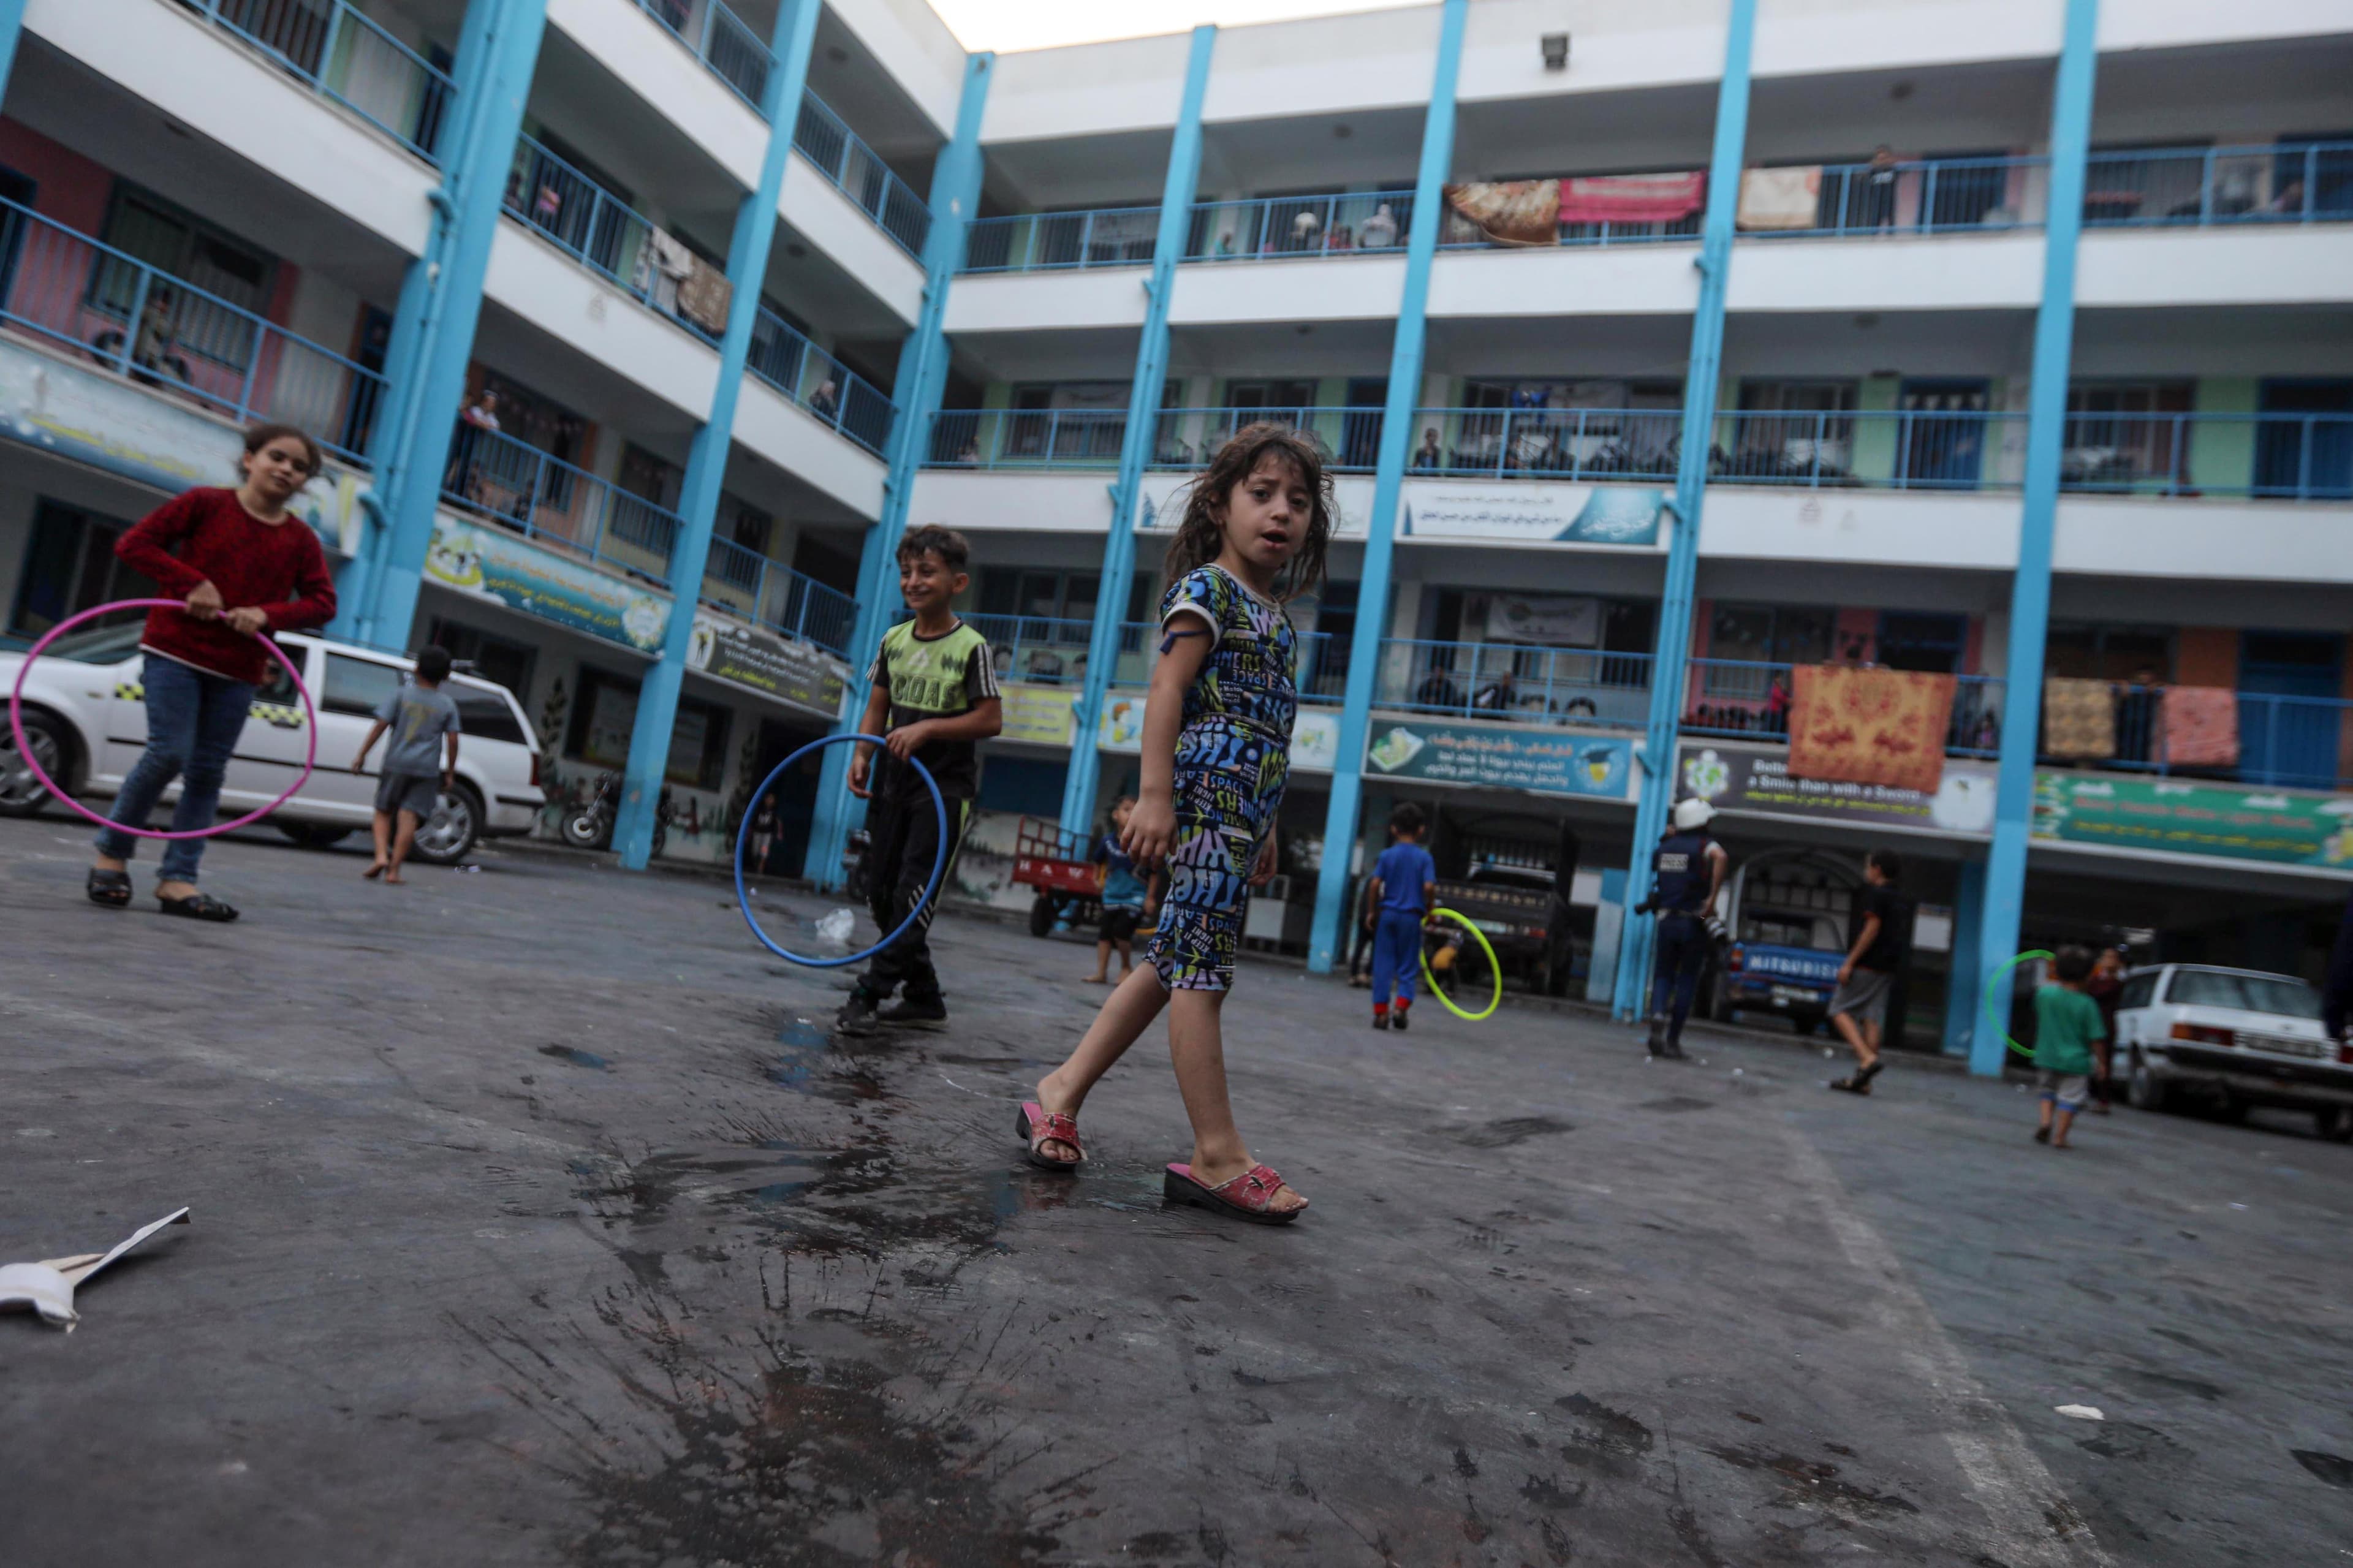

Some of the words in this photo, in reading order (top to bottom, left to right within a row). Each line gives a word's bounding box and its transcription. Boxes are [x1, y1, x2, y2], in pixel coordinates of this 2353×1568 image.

[1232, 668, 1267, 686] SPACE
[892, 674, 964, 710] DIDAS
[1753, 759, 1789, 774] Bette
[1173, 769, 1210, 788] EART
[1210, 775, 1245, 796] SPACE
[1748, 775, 1757, 788] a
[1798, 778, 1829, 793] than
[1831, 781, 1861, 797] with
[1862, 786, 1873, 797] a
[1192, 784, 1215, 802] LIGHT
[1194, 798, 1213, 811] KEEP
[1230, 836, 1249, 877] GREAT
[1183, 931, 1192, 941] IT
[1191, 925, 1214, 944] LIGHT
[1191, 939, 1211, 953] KEEP
